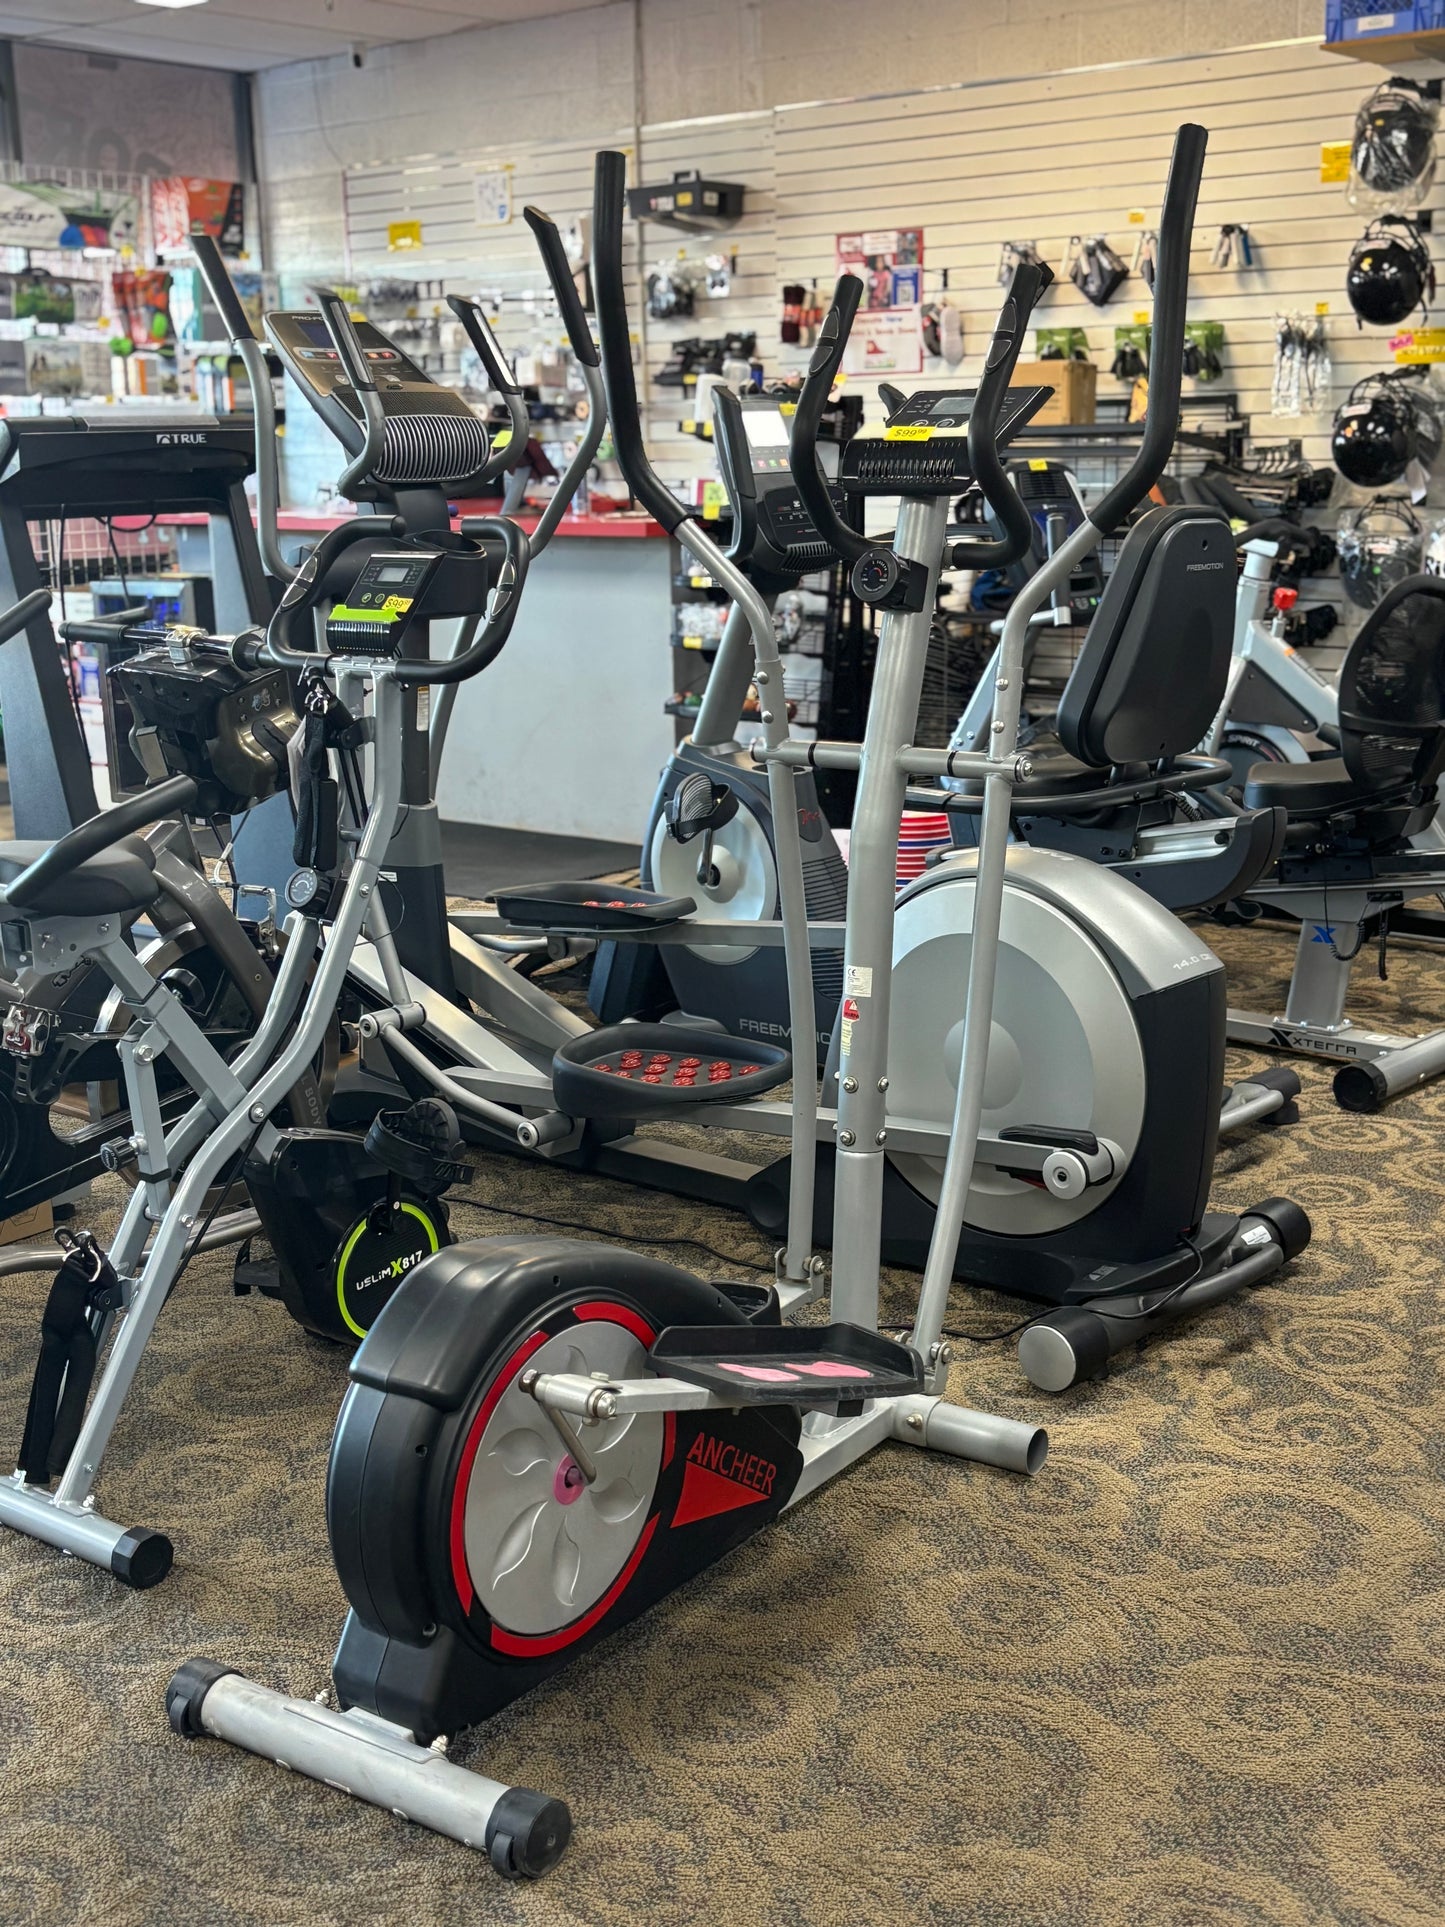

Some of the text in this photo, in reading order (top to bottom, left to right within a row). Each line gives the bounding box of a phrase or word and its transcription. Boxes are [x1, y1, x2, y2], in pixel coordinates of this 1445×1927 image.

[171, 433, 207, 444] TRUE
[1186, 562, 1224, 571] FREEMOTION
[1228, 734, 1260, 748] SPIRIT
[1172, 955, 1200, 970] 14.0
[738, 1017, 832, 1045] FREEMIO
[1293, 1036, 1357, 1056] XTERRA
[304, 1087, 322, 1125] BODY
[686, 1431, 777, 1495] ANCHEER
